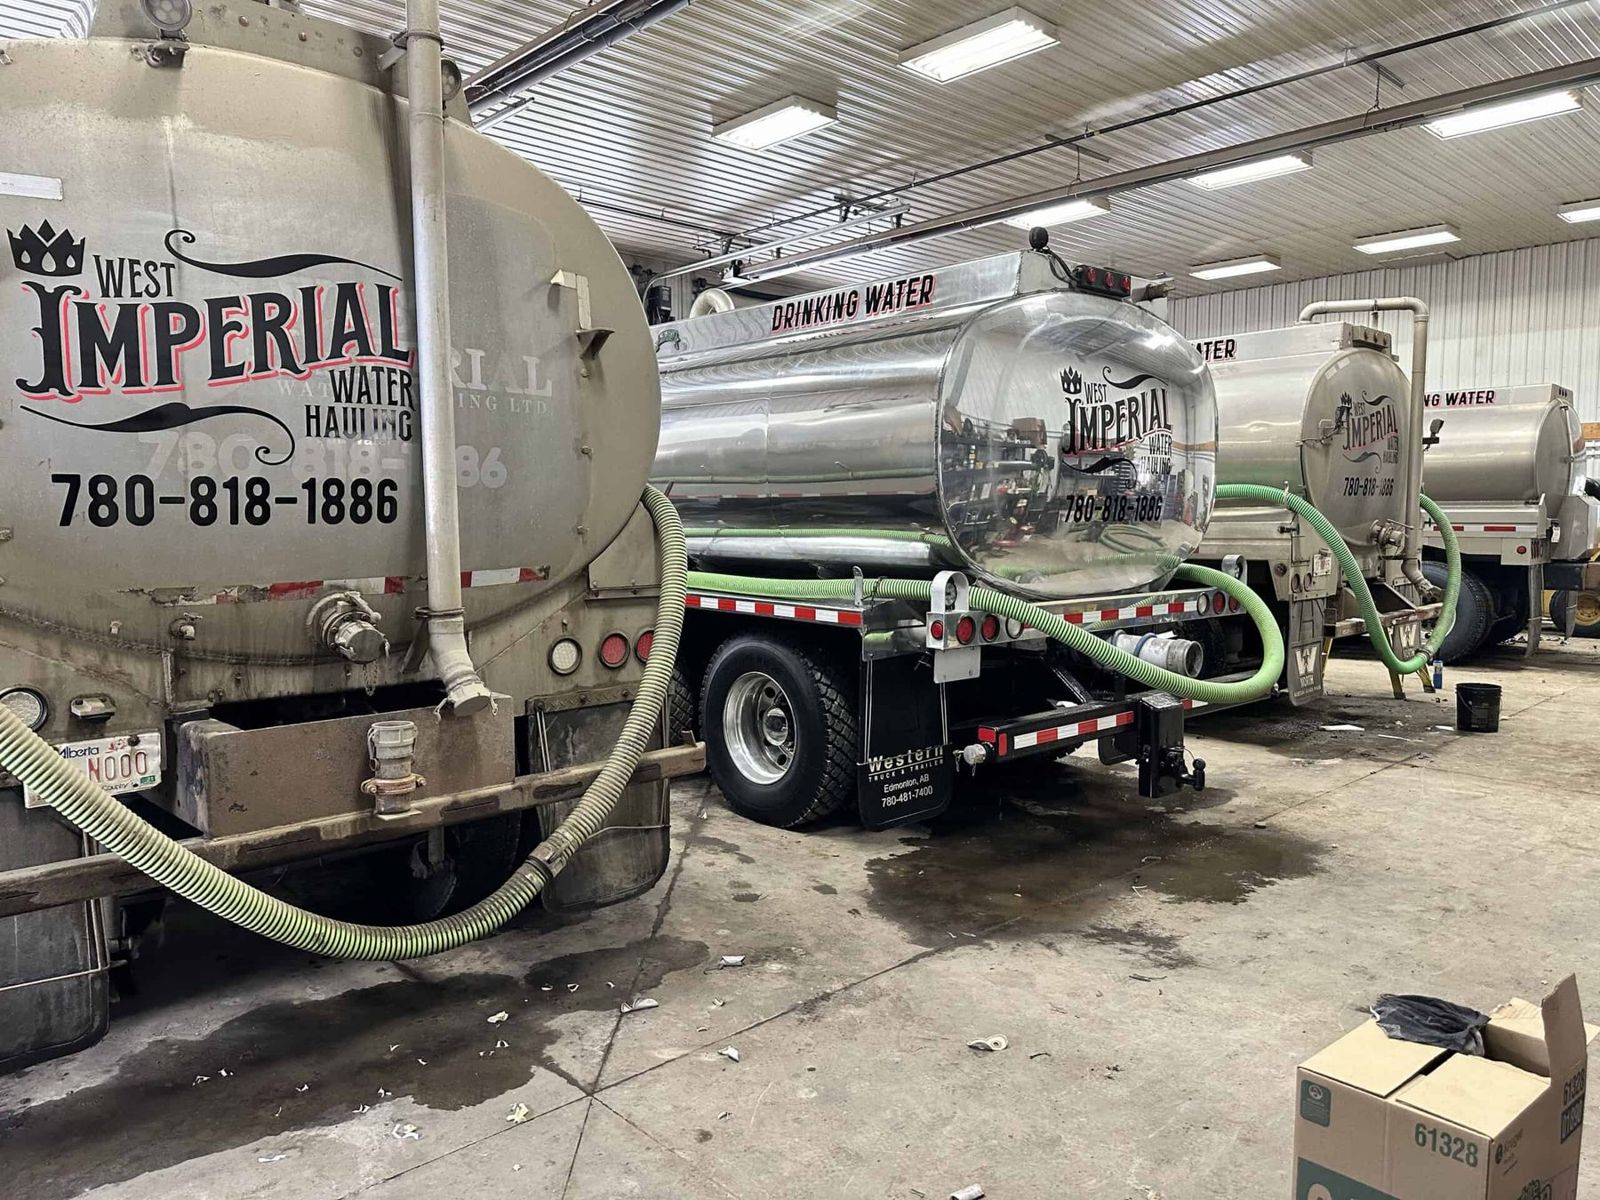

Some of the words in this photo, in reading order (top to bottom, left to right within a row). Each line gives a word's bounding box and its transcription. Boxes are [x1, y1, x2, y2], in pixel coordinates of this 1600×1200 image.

[93, 254, 176, 298] WEST
[772, 289, 860, 334] DRINKING
[865, 274, 936, 317] WATER
[15, 281, 417, 403] IMPERIAL
[329, 365, 417, 411] WATER
[1084, 382, 1107, 404] WEST
[1445, 390, 1496, 406] WATER
[304, 404, 413, 442] HAULING
[1062, 387, 1173, 458] IMPERIAL
[1342, 404, 1399, 452] IMPERIAL
[1149, 433, 1172, 457] WATER
[51, 473, 399, 527] 780-818-1886
[1065, 495, 1163, 522] 780-818-1886
[57, 746, 99, 759] Alberta
[868, 746, 943, 773] Western
[868, 771, 896, 782] TRUCK
[883, 779, 919, 793] Edmonton,
[919, 773, 930, 783] AB
[881, 785, 933, 807] 780-481-7400
[1414, 1122, 1479, 1168] 61328
